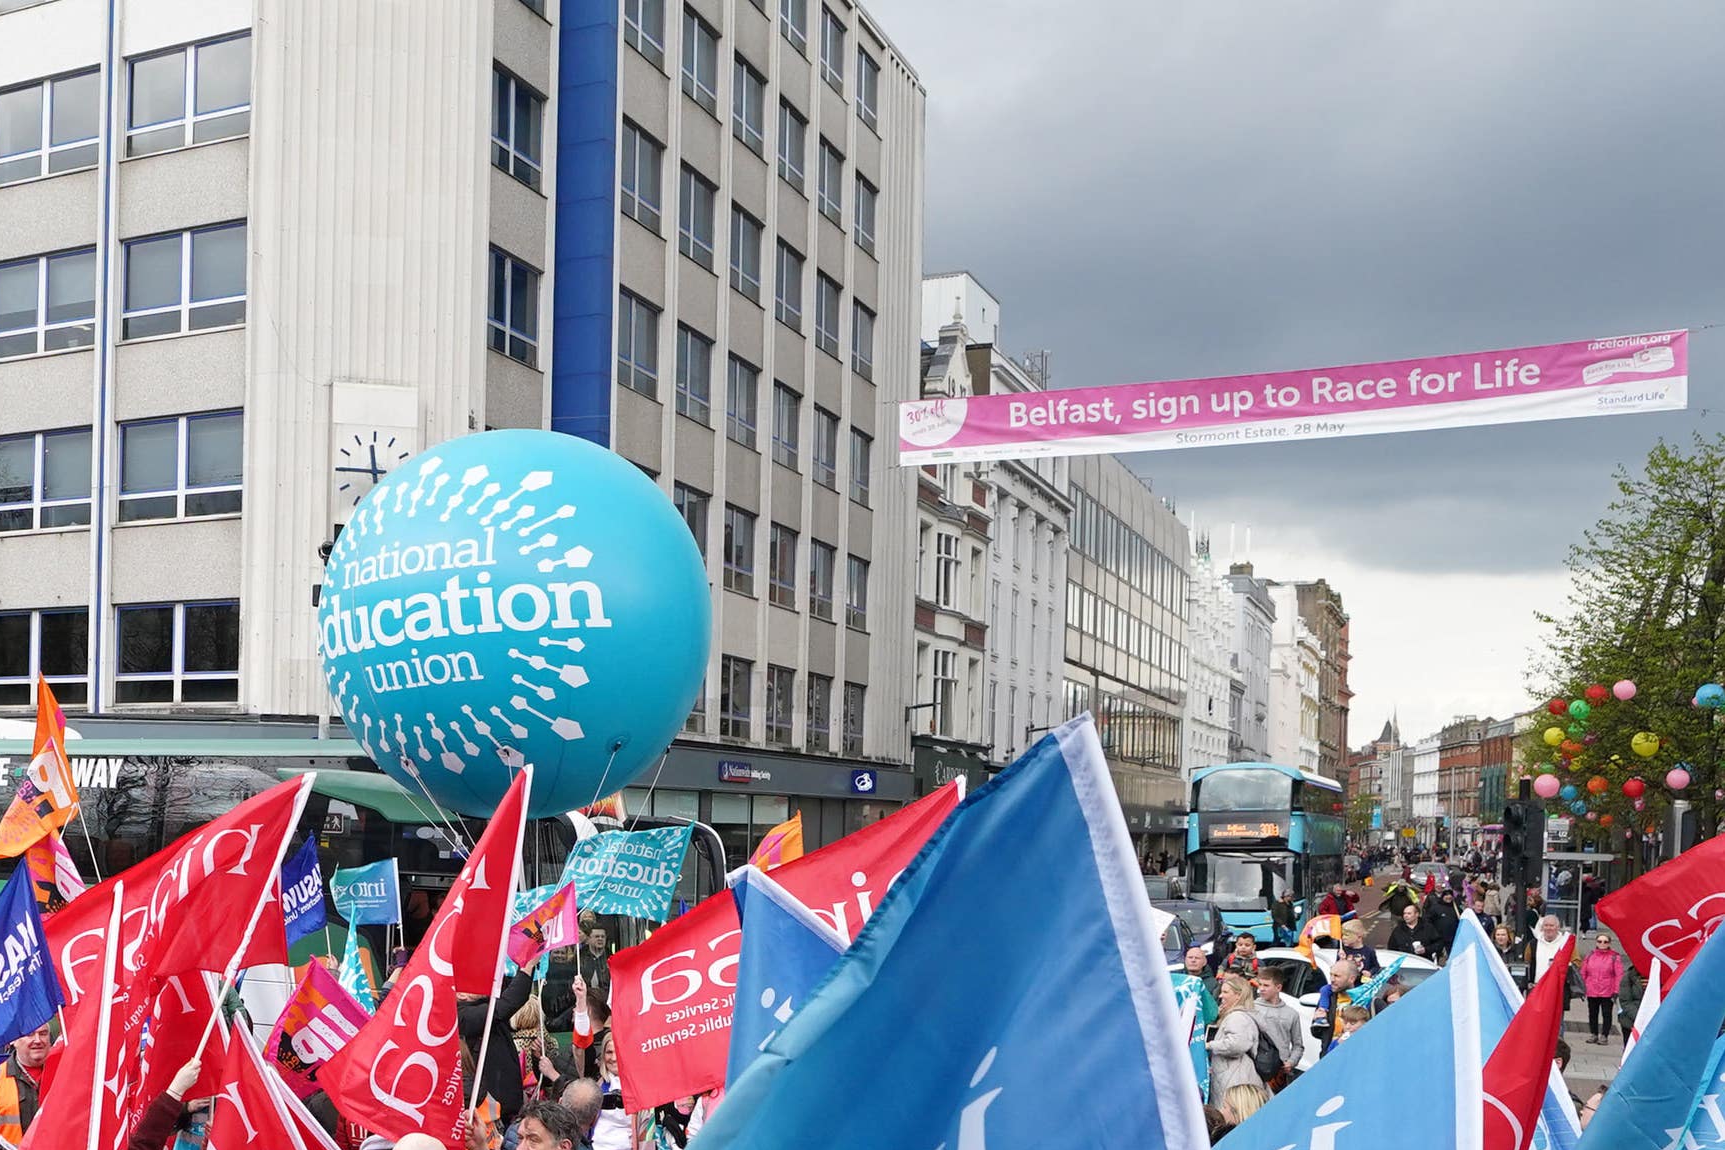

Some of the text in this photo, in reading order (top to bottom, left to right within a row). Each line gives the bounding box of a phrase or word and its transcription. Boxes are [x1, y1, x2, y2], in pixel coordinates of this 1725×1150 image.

[1009, 358, 1541, 429] Belfast, sign up to Race for Life
[1597, 391, 1666, 405] Standard Life
[1175, 428, 1241, 445] Stormont
[1293, 423, 1312, 435] 28
[1315, 422, 1346, 435] May
[342, 527, 497, 589] national
[365, 647, 484, 694] union
